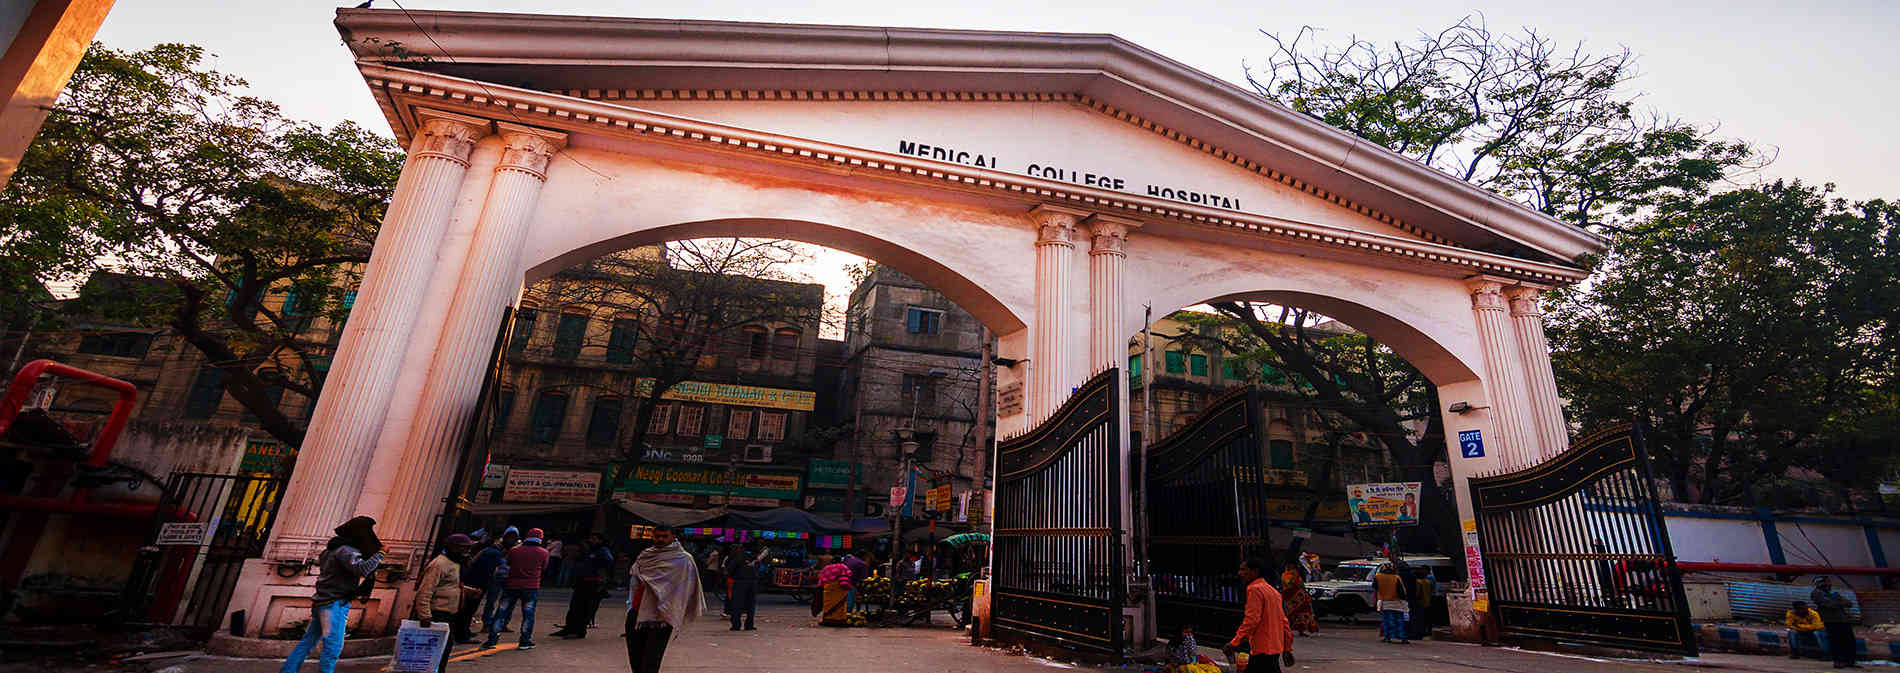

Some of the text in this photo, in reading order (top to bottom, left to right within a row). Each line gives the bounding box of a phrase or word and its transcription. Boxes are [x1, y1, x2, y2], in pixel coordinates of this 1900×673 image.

[899, 140, 996, 169] MEDICAL
[1460, 432, 1481, 442] GATE
[1467, 442, 1479, 456] 2
